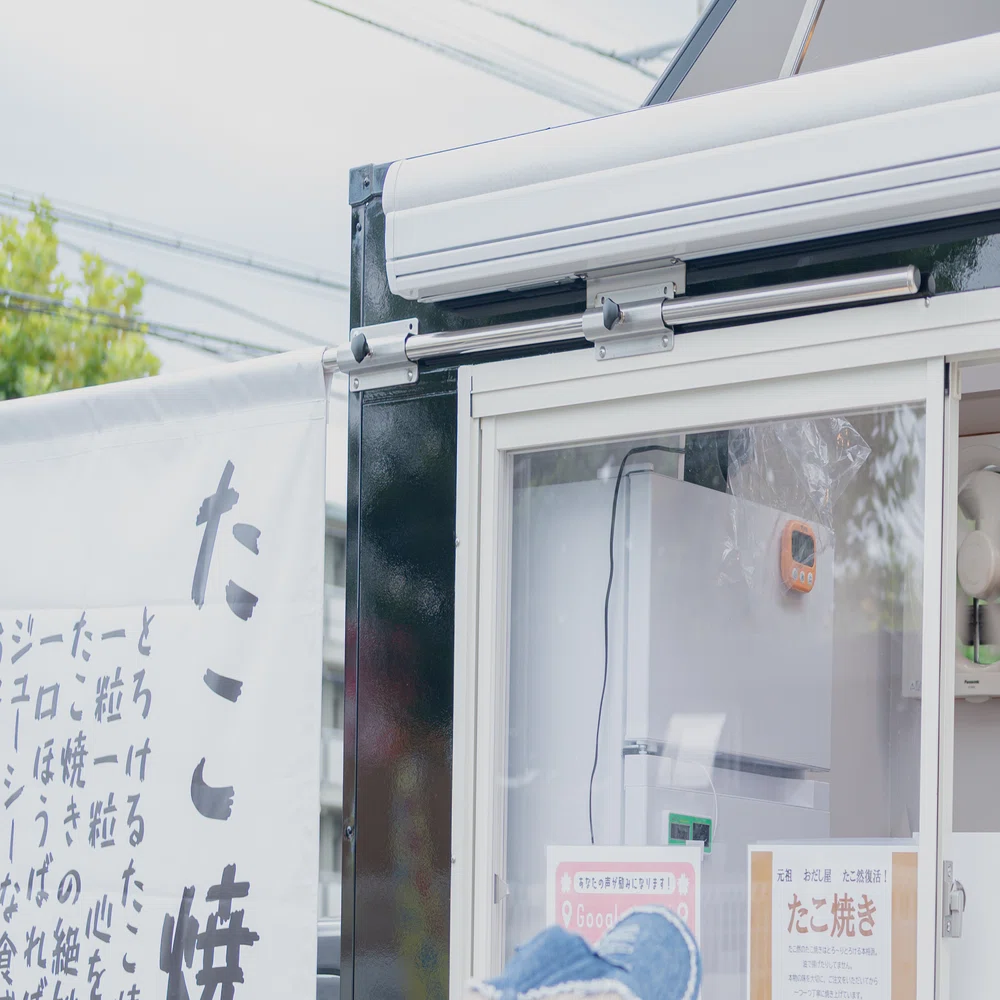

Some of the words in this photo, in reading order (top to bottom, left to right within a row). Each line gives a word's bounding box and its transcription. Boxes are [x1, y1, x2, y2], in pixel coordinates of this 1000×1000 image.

[776, 868, 793, 883] 元祖
[803, 868, 832, 883] おだし屋
[576, 903, 619, 929] Googl
[787, 892, 877, 938] たこ焼き
